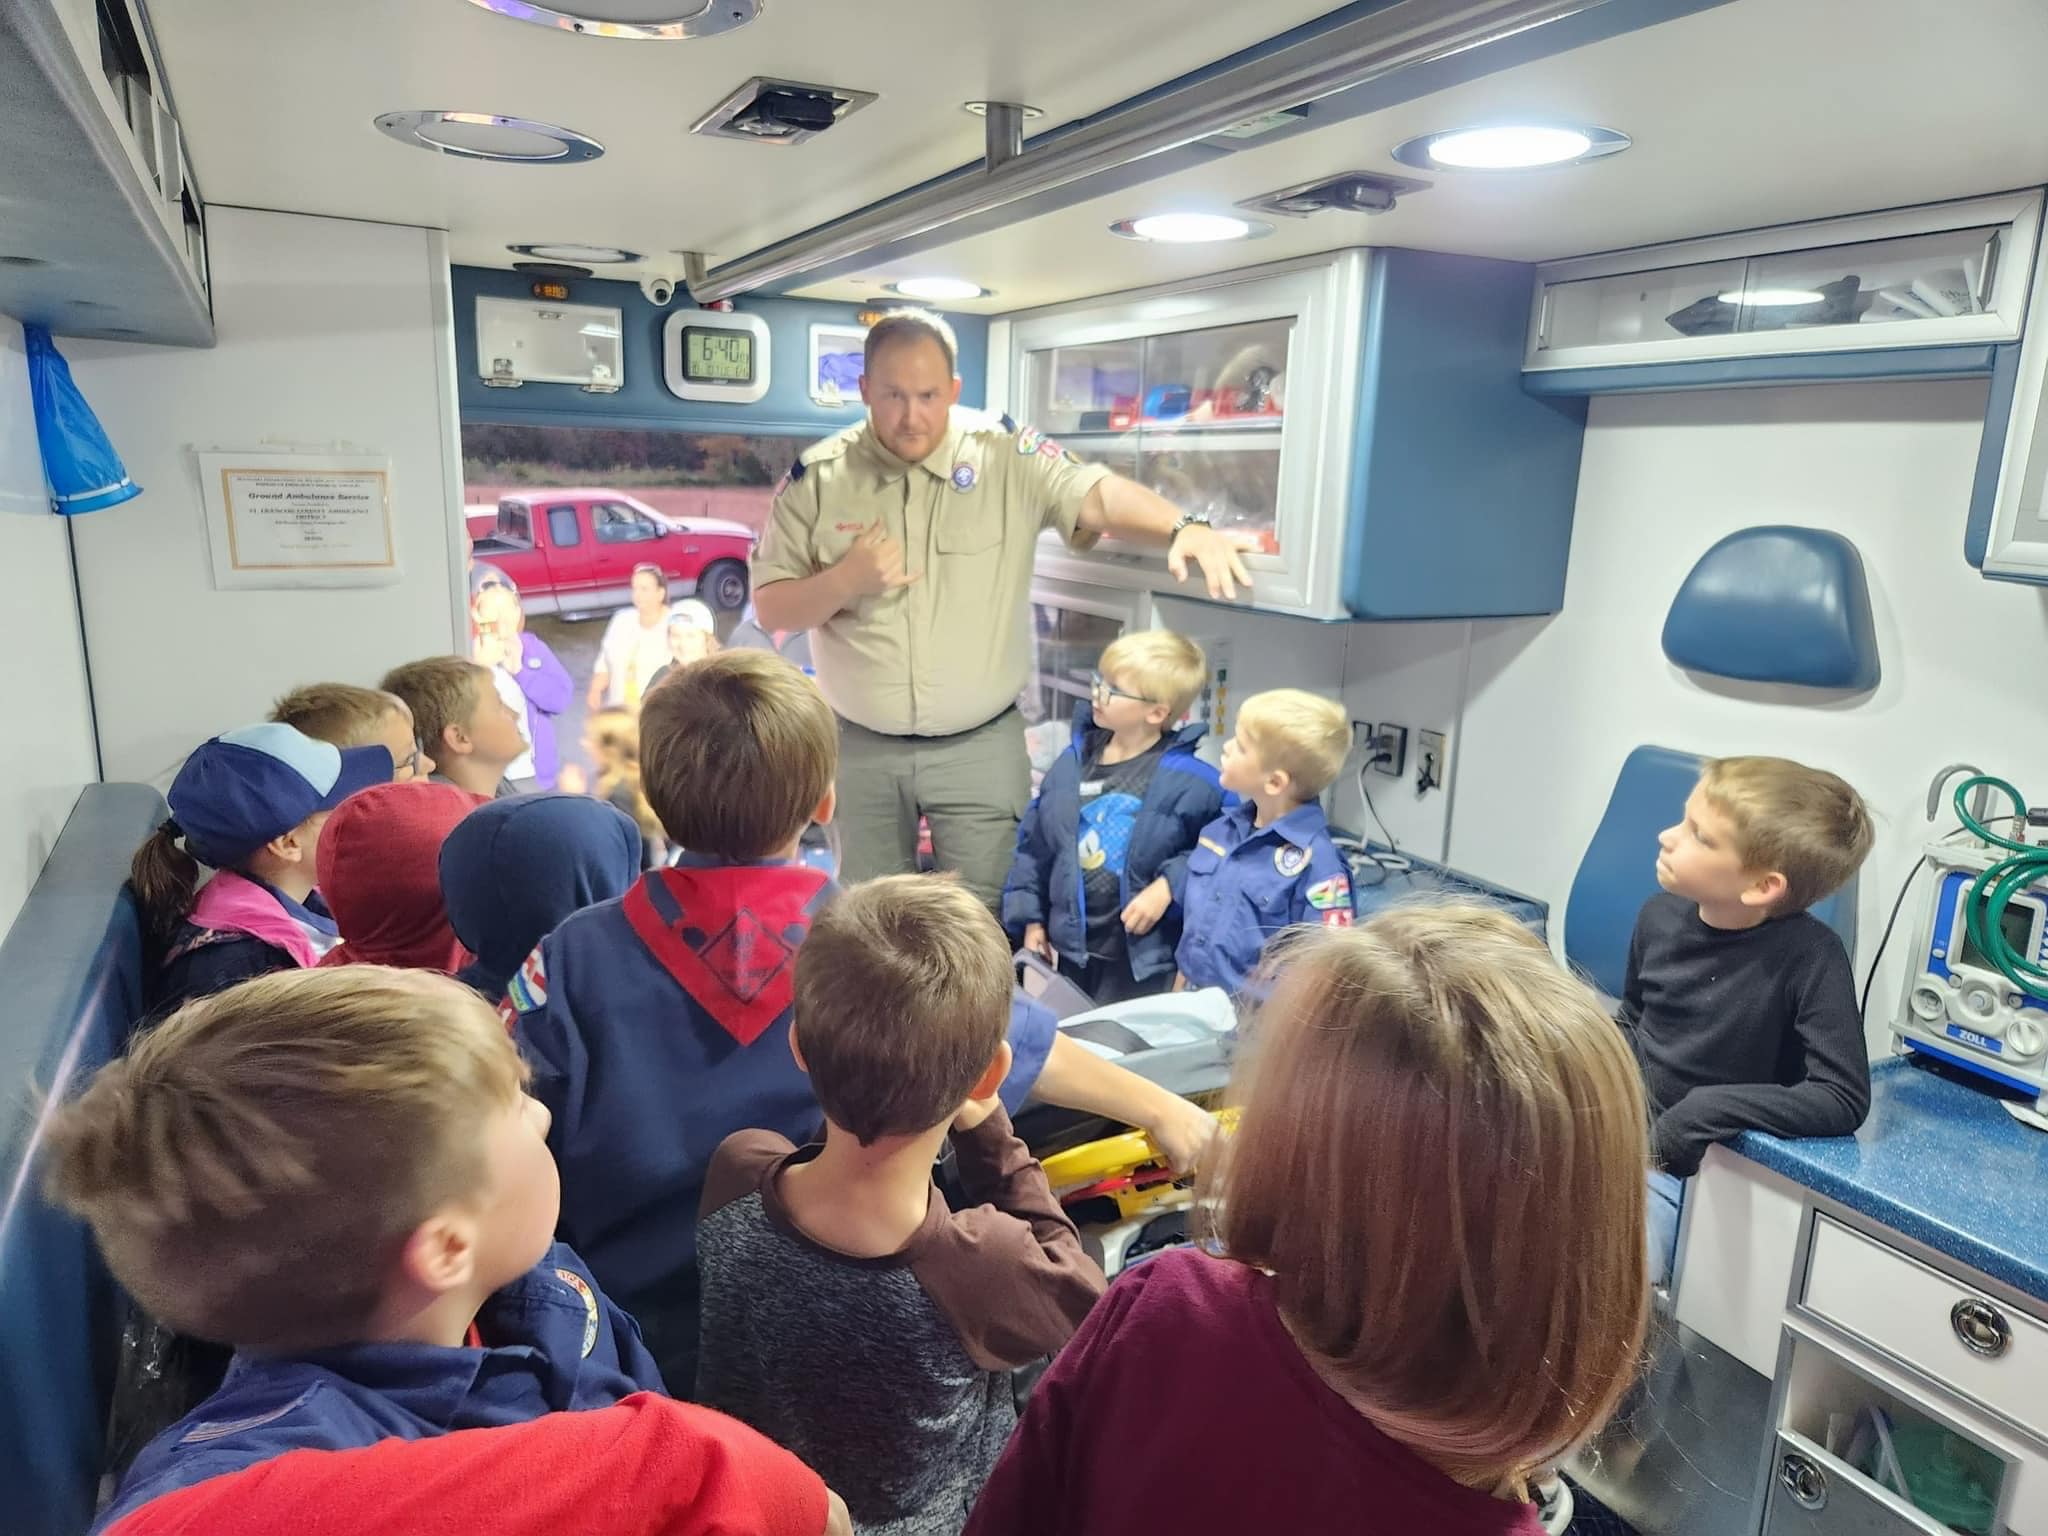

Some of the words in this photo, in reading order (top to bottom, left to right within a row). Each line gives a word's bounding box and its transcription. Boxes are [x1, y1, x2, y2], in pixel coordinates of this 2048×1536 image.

[703, 337, 740, 362] 6:40
[248, 492, 283, 500] Ground
[286, 492, 335, 500] Ambulance
[1959, 1029, 1987, 1048] ZOLL
